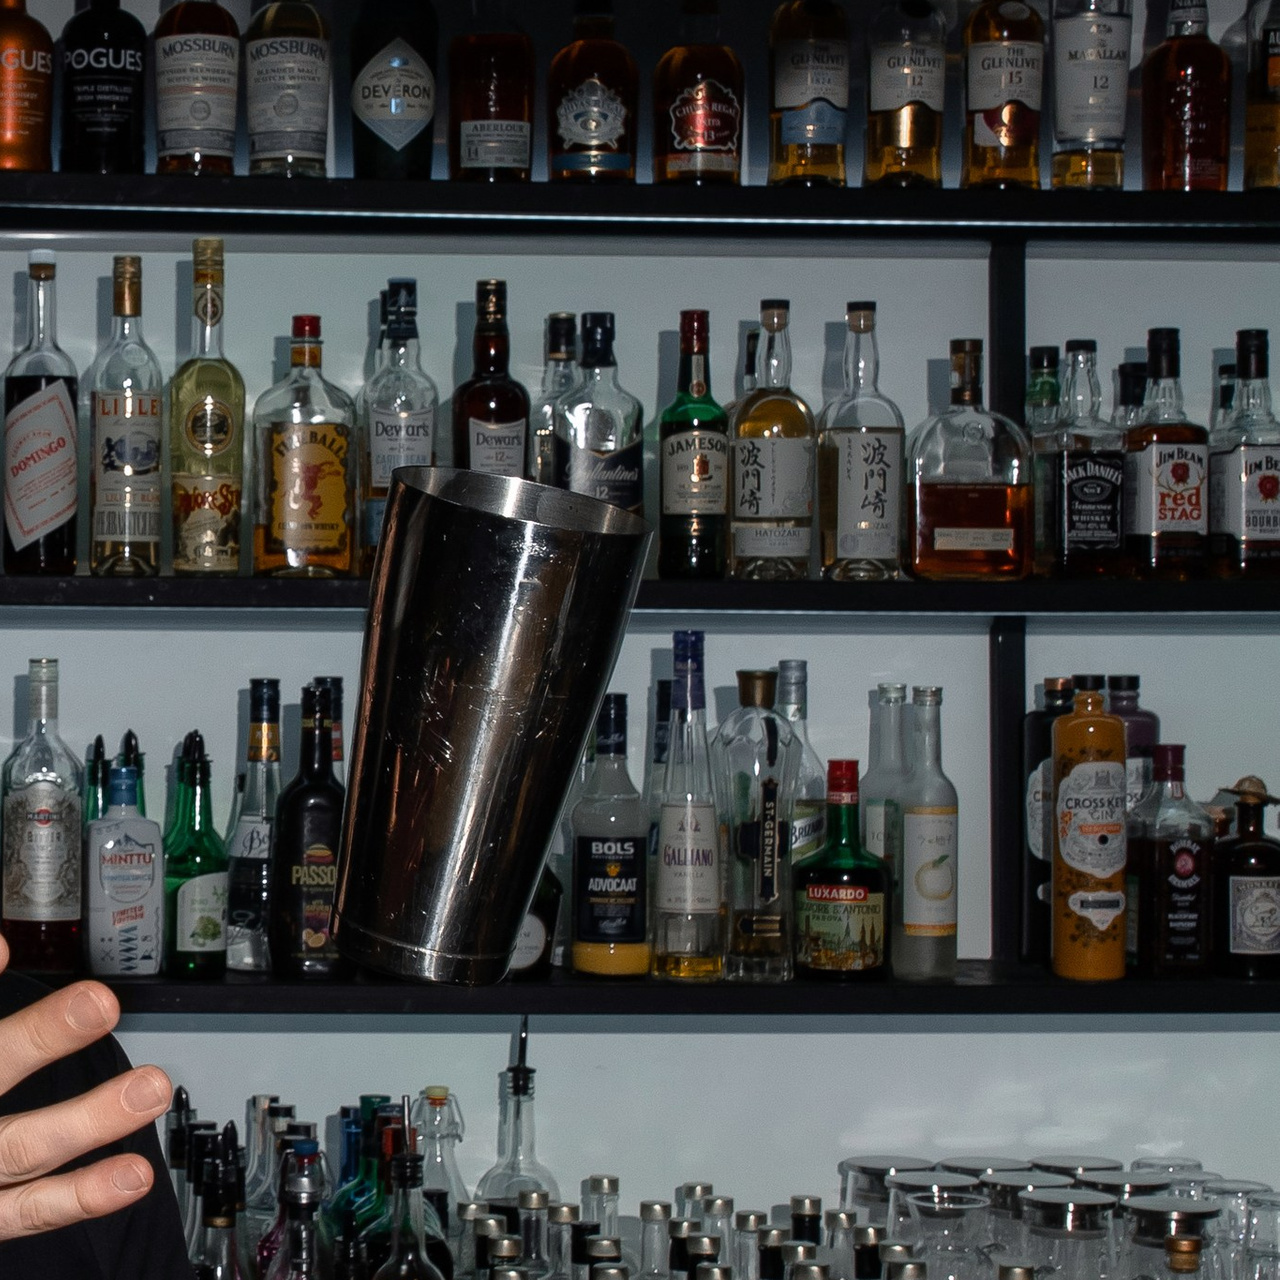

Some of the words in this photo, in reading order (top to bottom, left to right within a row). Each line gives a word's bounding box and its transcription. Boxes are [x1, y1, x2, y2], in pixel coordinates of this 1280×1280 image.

[162, 39, 235, 60] MOSSBURN
[250, 39, 326, 62] MOSSBURN
[65, 46, 142, 71] POGUES
[912, 77, 923, 86] 12
[1009, 72, 1022, 84] 15
[1093, 76, 1109, 89] 12
[472, 125, 524, 133] ABERLOUR
[704, 131, 715, 140] 13
[375, 421, 429, 437] Dewar's
[477, 433, 522, 446] Dewar's
[669, 438, 727, 455] JAMESON
[10, 437, 66, 478] DOMINGO
[495, 452, 505, 461] 12
[1156, 452, 1175, 468] JIM
[1177, 448, 1204, 466] BEAM
[1244, 461, 1262, 476] JIM
[596, 486, 609, 499] 12
[1159, 486, 1200, 507] red
[1158, 508, 1202, 520] STAG
[754, 530, 800, 538] HATOZAKI
[1065, 798, 1104, 809] CROSS
[764, 801, 775, 877] ST-GERMAIN
[592, 842, 635, 854] BOLS
[102, 853, 152, 865] MINTTU
[588, 878, 638, 892] ADVOCAAT
[809, 888, 865, 899] LUXARDO
